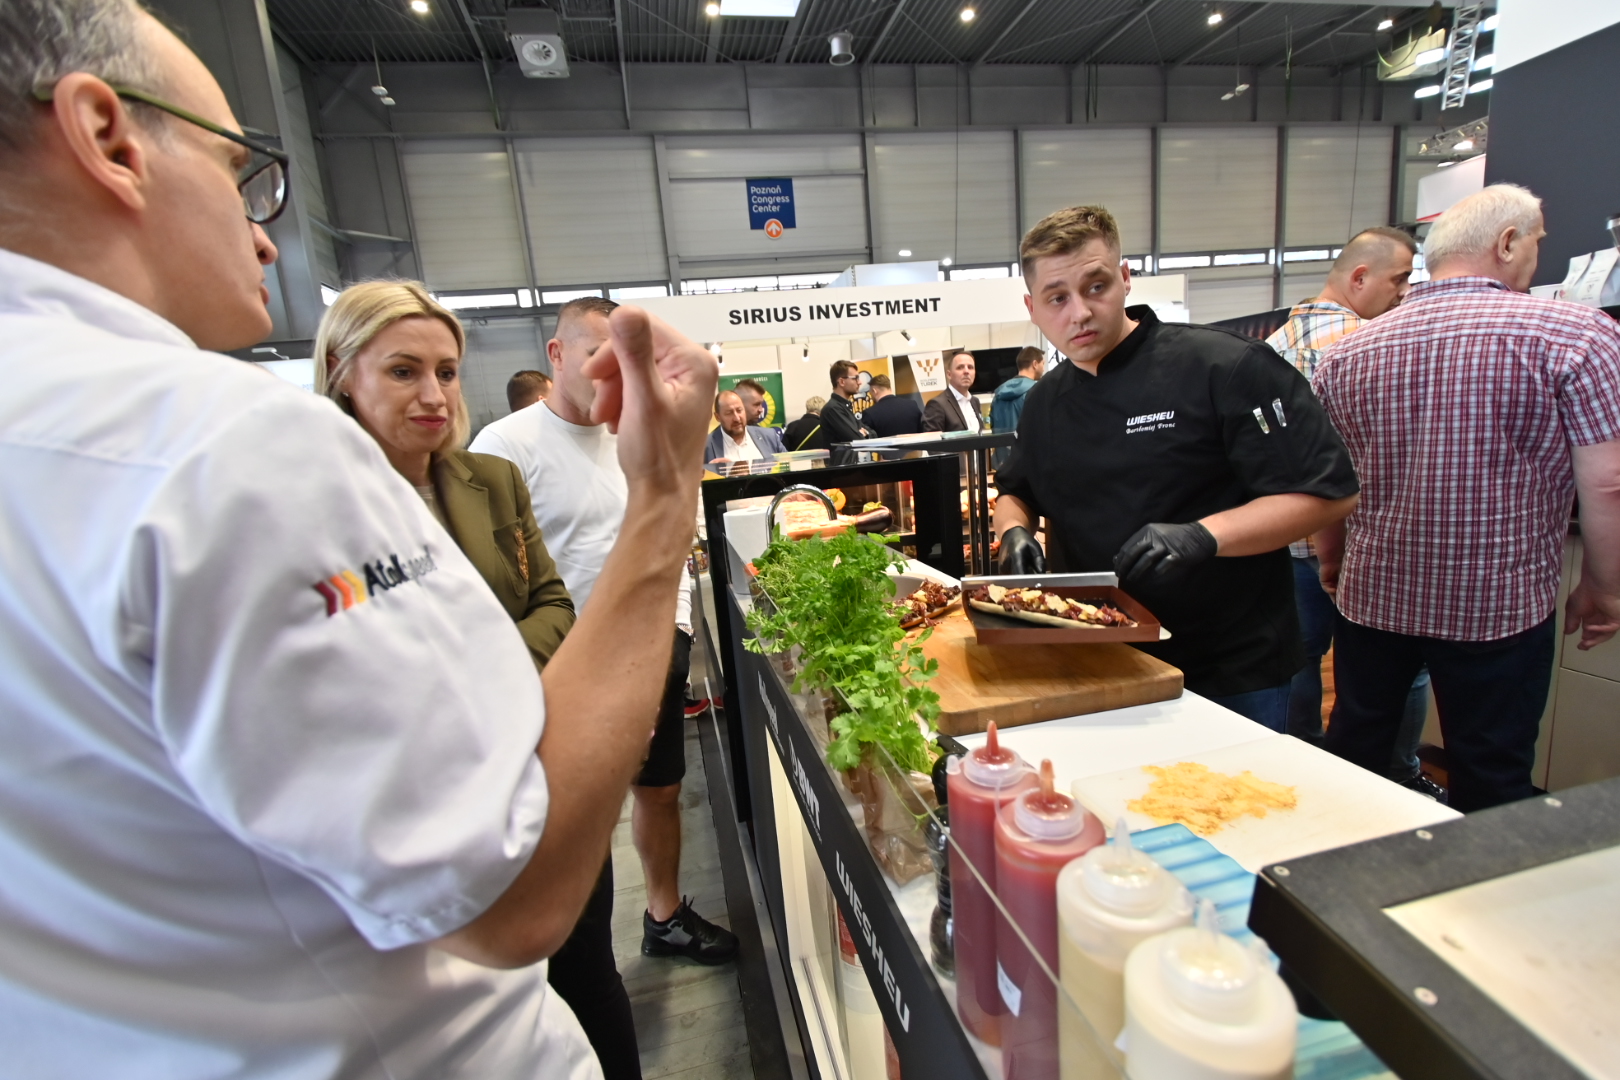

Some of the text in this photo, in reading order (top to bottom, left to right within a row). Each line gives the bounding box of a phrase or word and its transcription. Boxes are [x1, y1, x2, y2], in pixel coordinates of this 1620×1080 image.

[750, 185, 782, 195] Poznań
[751, 195, 790, 205] Congress
[752, 204, 780, 213] Center
[728, 297, 941, 325] SIRIUS INVESTMENT
[1126, 411, 1174, 426] WIESHEU
[835, 850, 910, 1034] WIESHEU
